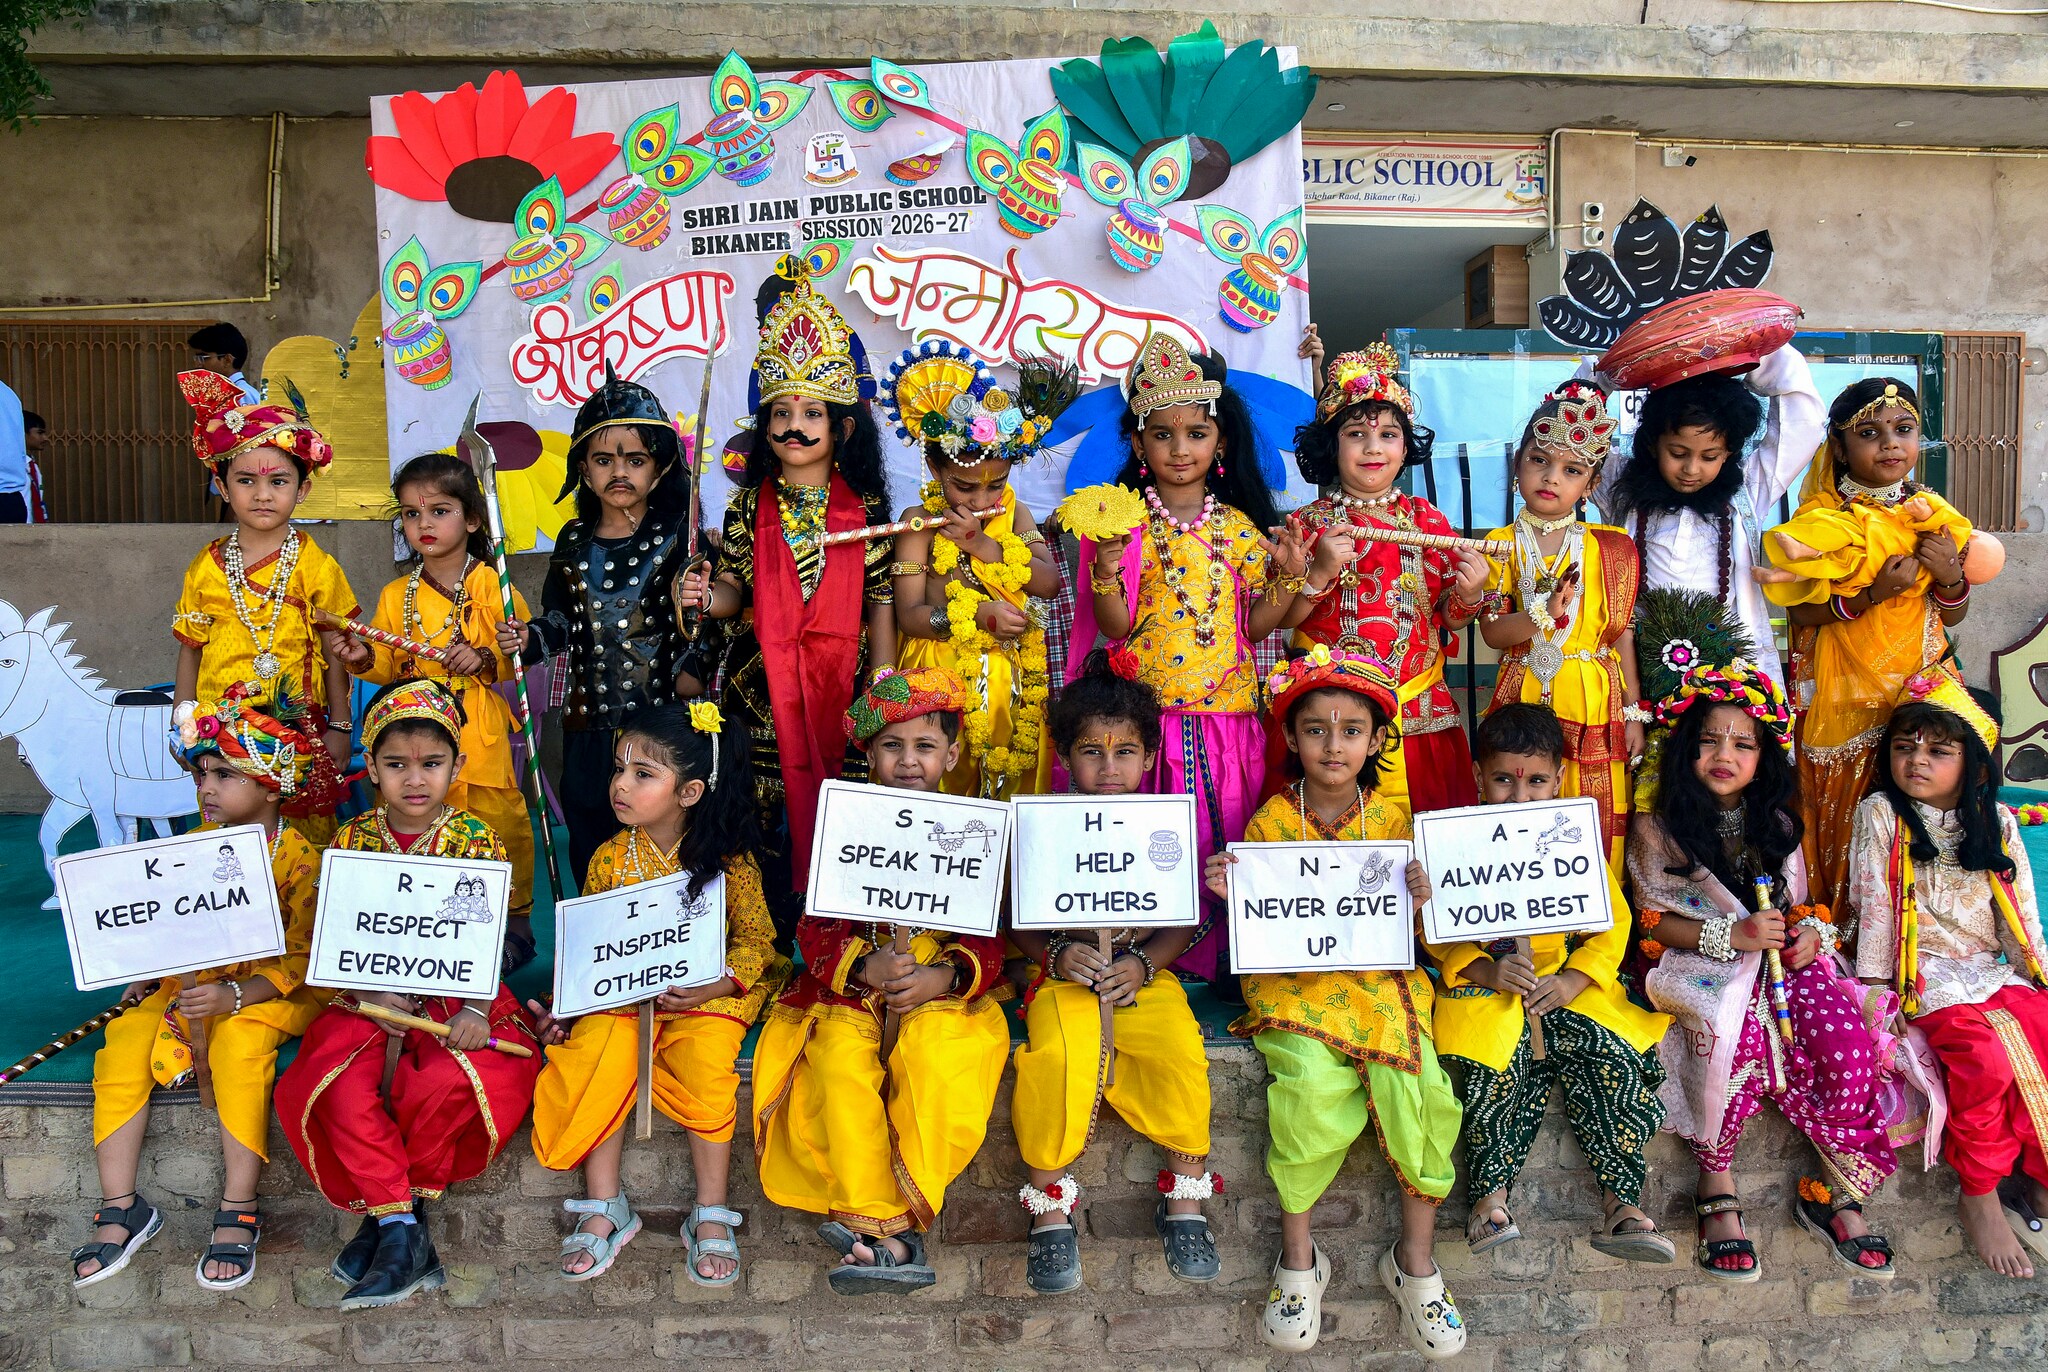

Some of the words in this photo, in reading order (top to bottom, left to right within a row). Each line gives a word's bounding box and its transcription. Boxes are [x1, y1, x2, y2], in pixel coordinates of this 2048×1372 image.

[1374, 159, 1503, 187] SCHOOL
[683, 204, 740, 229] SHRI
[748, 199, 799, 223] JAIN
[810, 191, 893, 216] PUBLIC
[898, 185, 987, 209] SCHOOL
[1363, 193, 1396, 202] Bikaner
[1397, 194, 1421, 203] (Raj.)
[691, 231, 792, 256] BIKANER
[801, 217, 883, 242] SESSION
[891, 212, 969, 235] 2026-27
[1848, 355, 1908, 364] ekm.net.in
[838, 844, 919, 872] SPEAK
[929, 853, 982, 880] THE
[1076, 852, 1135, 873] HELP
[1440, 860, 1544, 889] ALWAYS
[1554, 855, 1589, 878] DO
[95, 900, 161, 931] KEEP
[174, 886, 251, 916] CALM
[861, 885, 950, 915] TRUTH
[1054, 890, 1158, 913] OTHERS
[1244, 897, 1326, 920] NEVER
[1336, 894, 1397, 917] GIVE
[1447, 902, 1517, 927] YOUR
[1526, 894, 1589, 919] BEST
[356, 911, 467, 940] RESPECT
[593, 922, 691, 964] INSPIRE
[1307, 936, 1337, 957] UP
[338, 950, 474, 982] EVERYONE
[593, 959, 689, 997] OTHERS
[1719, 1241, 1740, 1251] AIR
